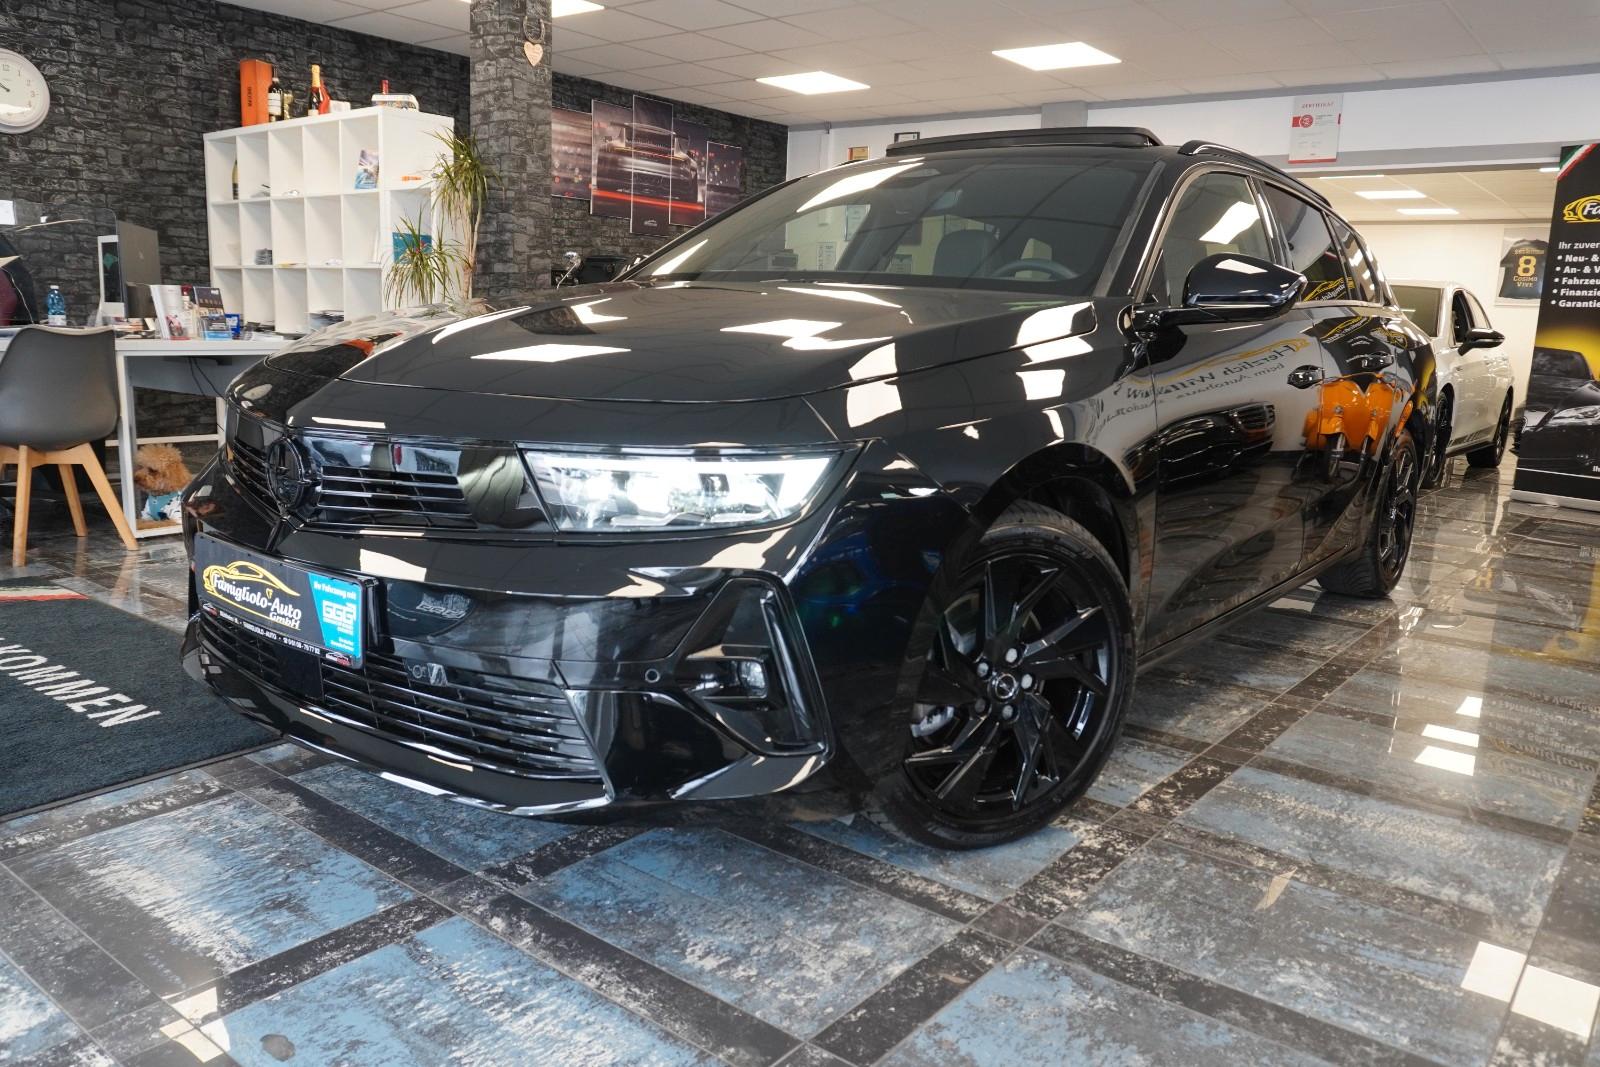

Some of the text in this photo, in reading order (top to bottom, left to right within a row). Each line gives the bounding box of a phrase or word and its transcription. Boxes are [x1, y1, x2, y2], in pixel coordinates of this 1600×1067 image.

[1558, 241, 1572, 249] Ihr
[1565, 254, 1589, 262] Neu-
[1517, 255, 1537, 277] 8
[1562, 265, 1581, 274] An-
[1583, 265, 1592, 274] &
[213, 573, 302, 619] Famigliolo-Auto
[269, 611, 301, 630] GmbH
